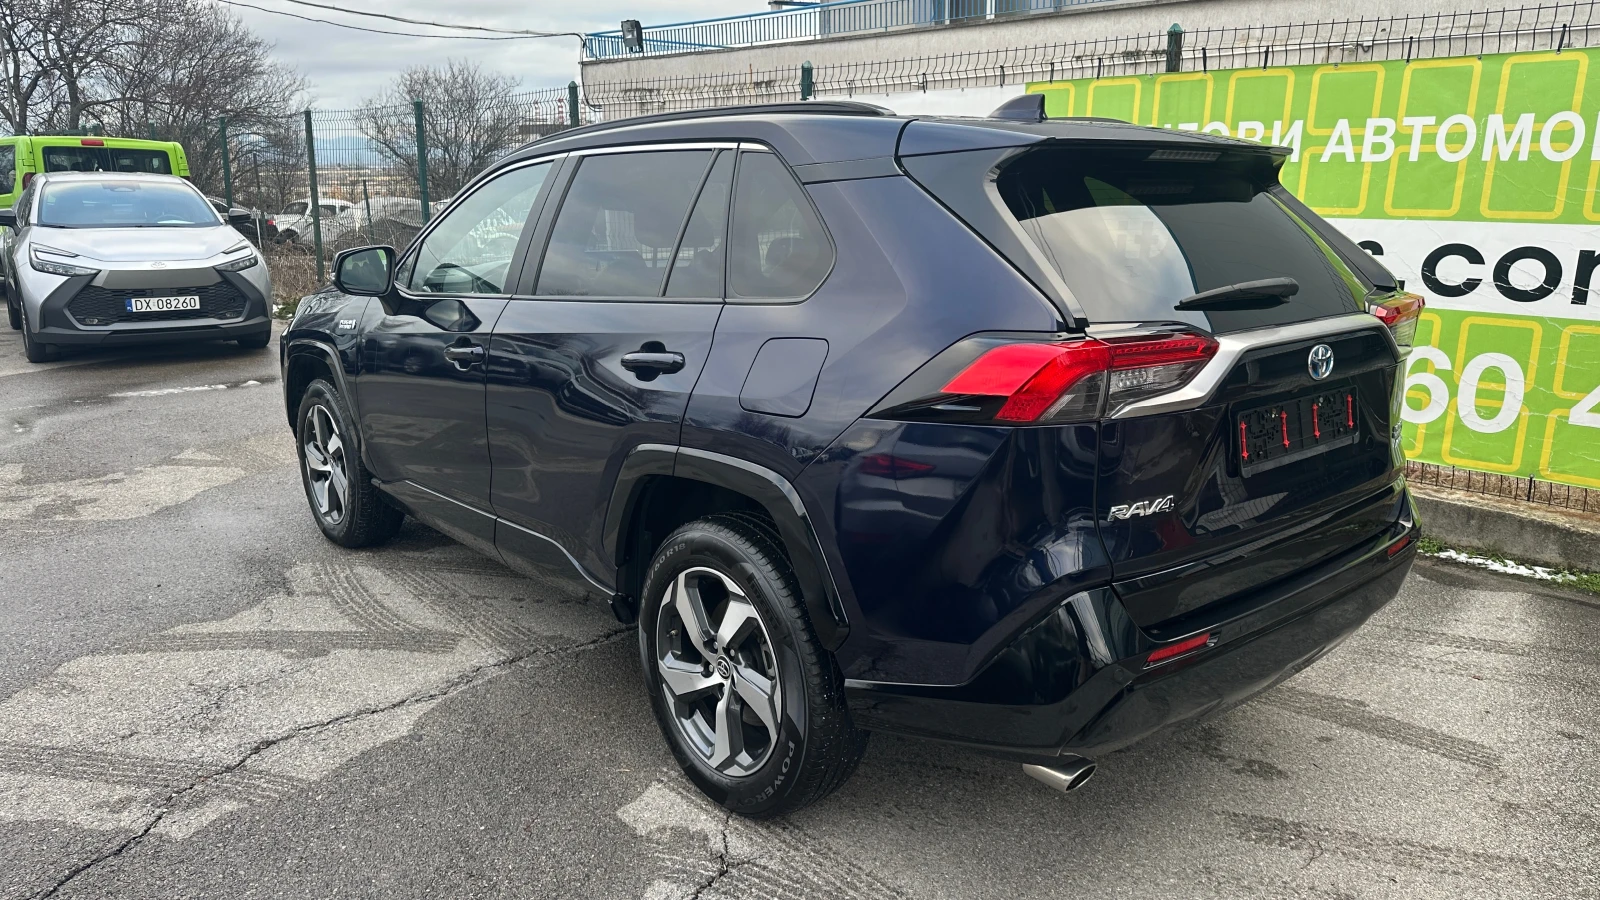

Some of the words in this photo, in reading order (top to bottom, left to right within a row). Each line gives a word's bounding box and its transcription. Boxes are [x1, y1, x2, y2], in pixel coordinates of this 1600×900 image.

[1319, 111, 1600, 163] АВТОМО
[134, 299, 152, 311] DX
[156, 297, 197, 310] 08260
[1107, 495, 1175, 521] RAV4
